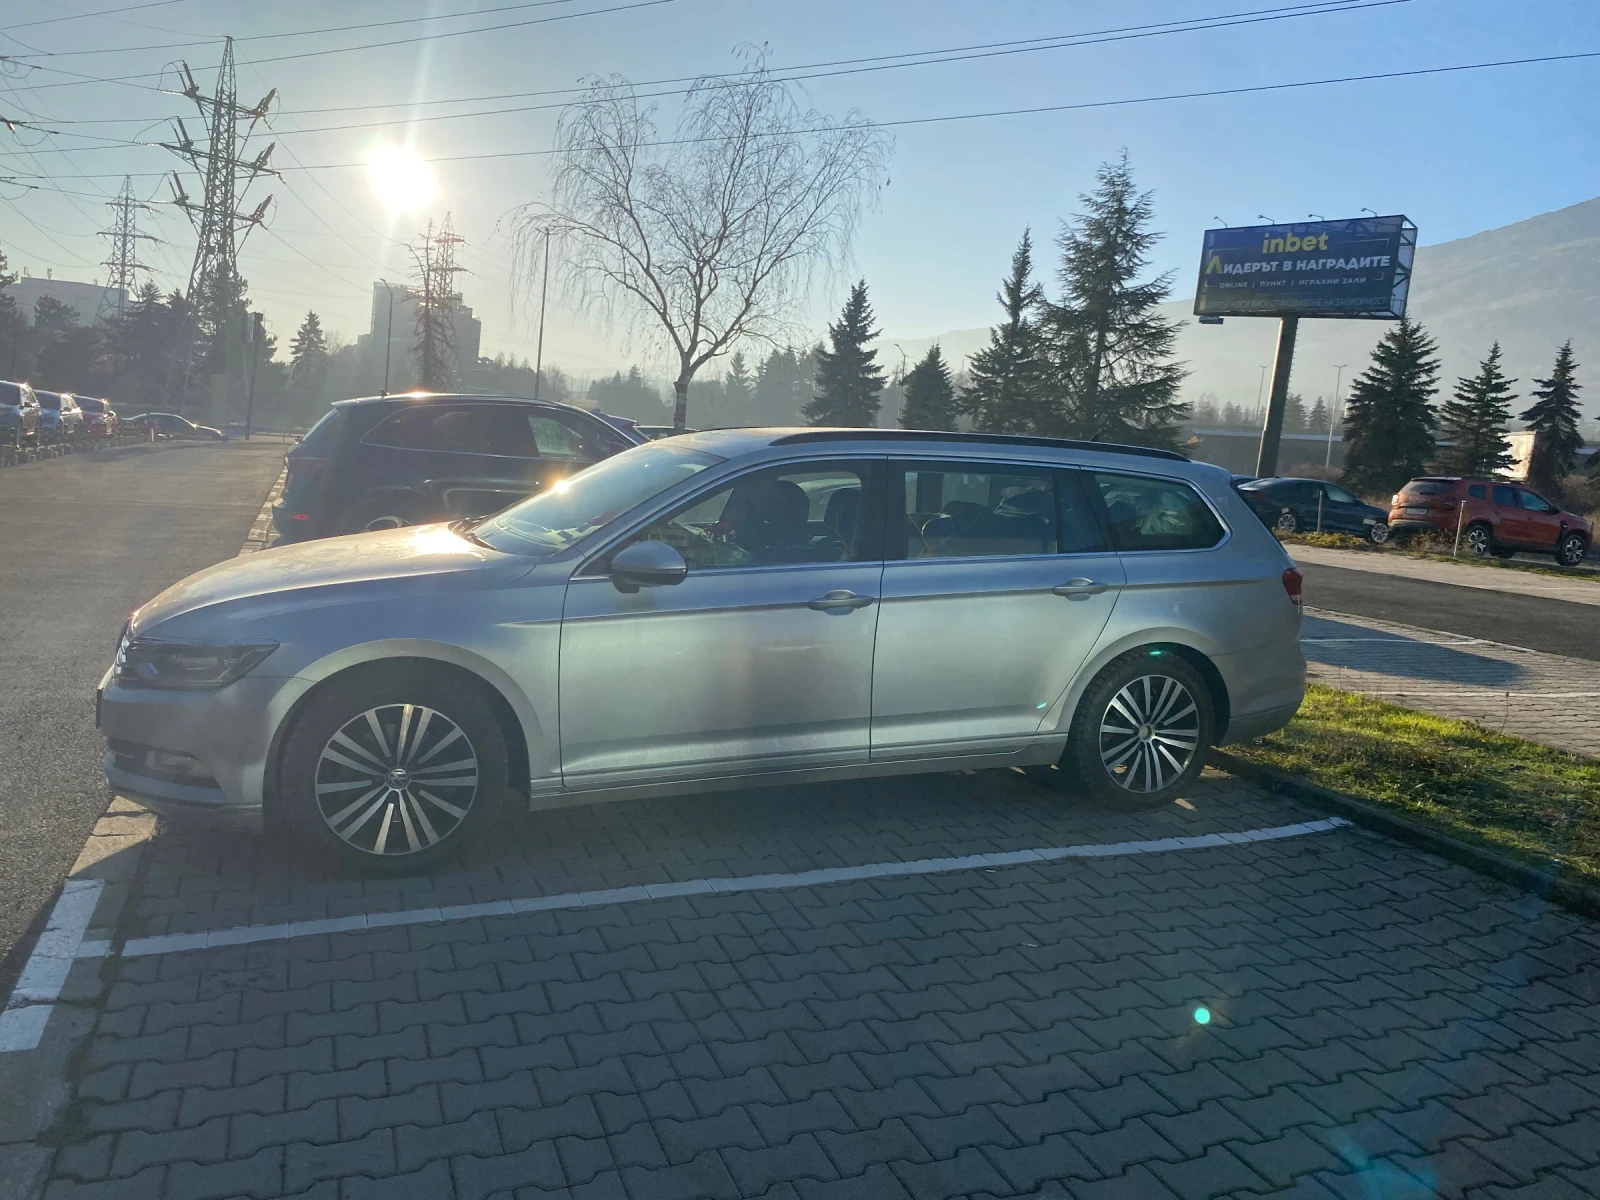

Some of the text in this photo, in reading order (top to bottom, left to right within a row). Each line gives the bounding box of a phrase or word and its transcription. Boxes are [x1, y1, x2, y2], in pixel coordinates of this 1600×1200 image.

[1262, 232, 1328, 254] inbet
[1205, 255, 1391, 275] ЛИДЕРЪТ В НАГРАДИТЕ
[1219, 281, 1248, 289] ONLINE
[1259, 280, 1287, 288] ПУНКТ
[1298, 278, 1340, 286] ИГРАЛНИ
[1342, 277, 1367, 285] ЗАЛИ
